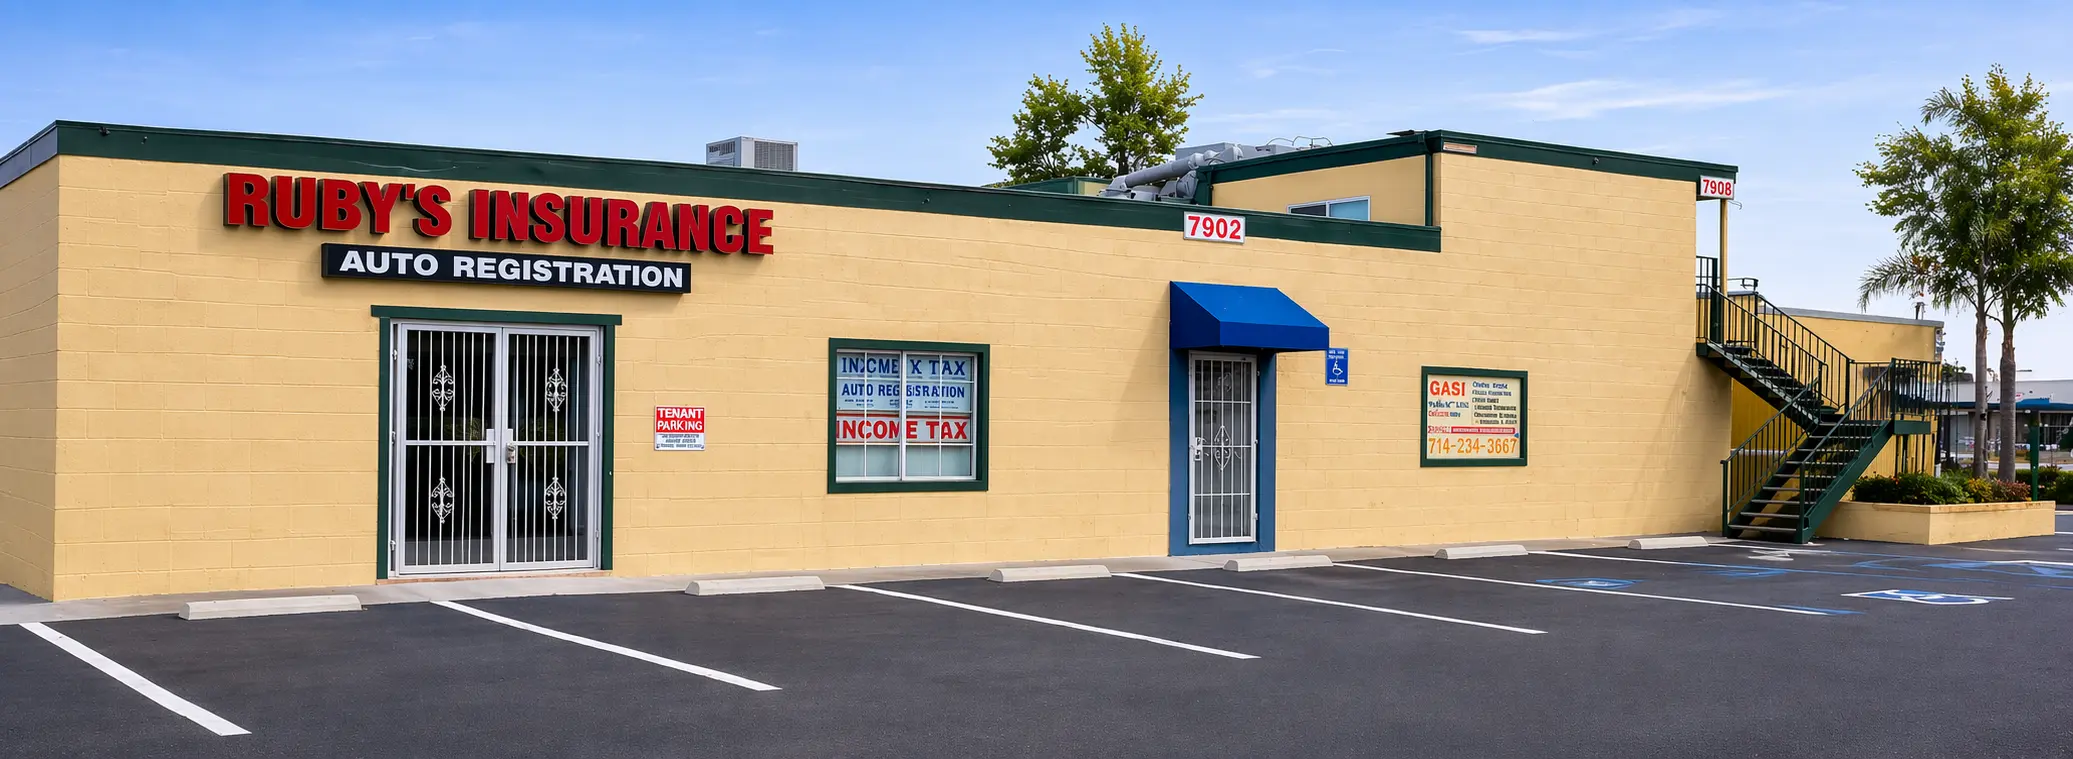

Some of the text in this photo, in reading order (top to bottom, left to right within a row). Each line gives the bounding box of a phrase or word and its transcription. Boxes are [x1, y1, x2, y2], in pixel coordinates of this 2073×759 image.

[1703, 179, 1731, 196] 7908
[225, 172, 774, 255] RUBY'S INSURANCE
[1188, 215, 1241, 240] 7902
[339, 250, 684, 289] AUTO REGISTRATION
[928, 360, 967, 376] TAX
[841, 383, 874, 396] AUTO
[1430, 380, 1465, 396] GASI
[657, 408, 704, 419] TENANT
[657, 420, 703, 431] PARKING
[836, 420, 968, 439] INCOME TAX
[1428, 437, 1518, 454] 714-234-3667
